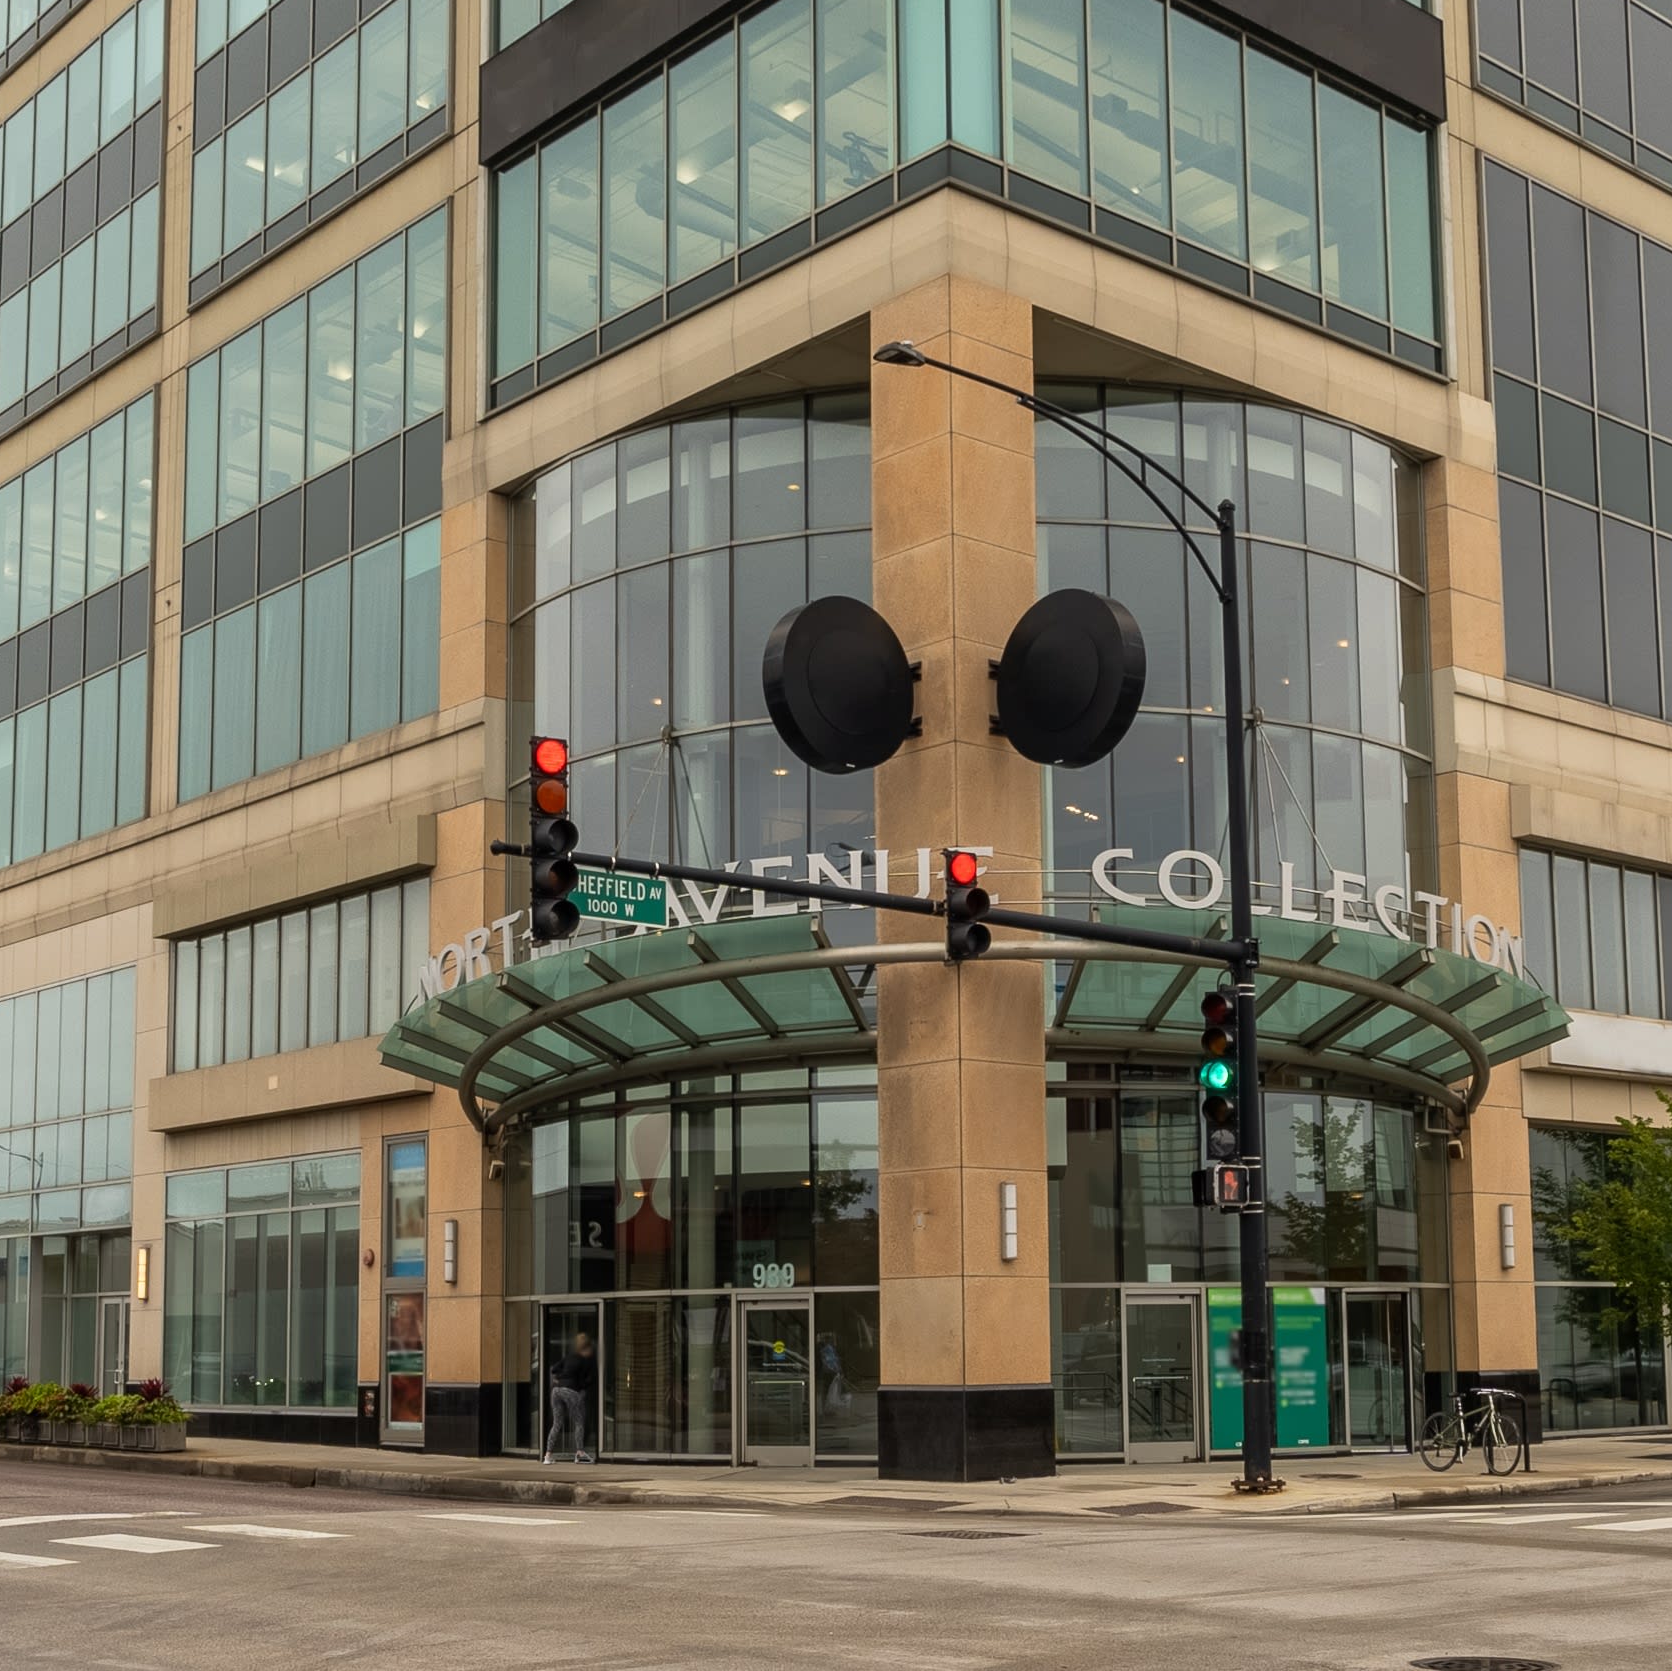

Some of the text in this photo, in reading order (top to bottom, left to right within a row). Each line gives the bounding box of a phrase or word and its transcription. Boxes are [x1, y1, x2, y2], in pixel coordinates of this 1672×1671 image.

[573, 874, 663, 901] HEFFIELD AV
[588, 898, 635, 917] 1000 W
[417, 908, 570, 1001] NORT
[1092, 848, 1524, 980] COLECTION
